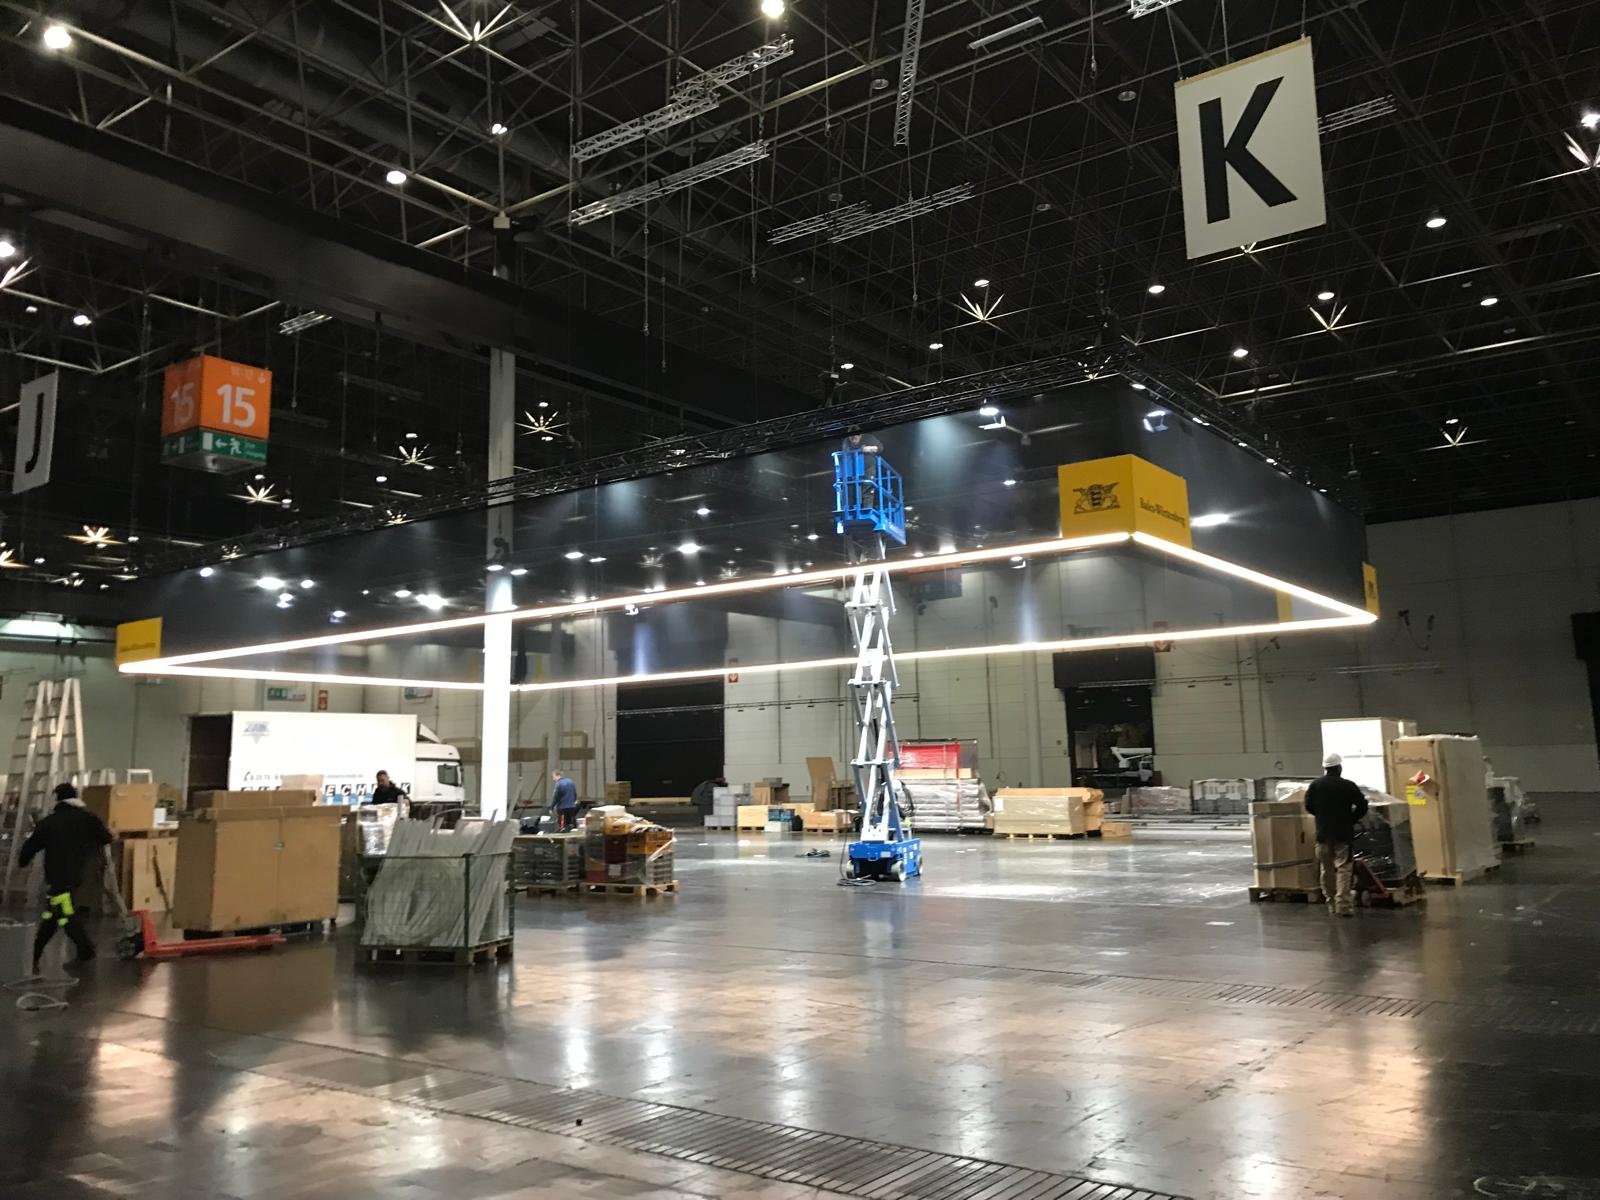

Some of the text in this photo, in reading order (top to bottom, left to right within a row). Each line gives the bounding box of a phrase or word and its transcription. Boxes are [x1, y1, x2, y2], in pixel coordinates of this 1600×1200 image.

[1198, 76, 1298, 224] K
[24, 391, 45, 474] J
[170, 381, 196, 428] 15
[216, 383, 256, 428] 15
